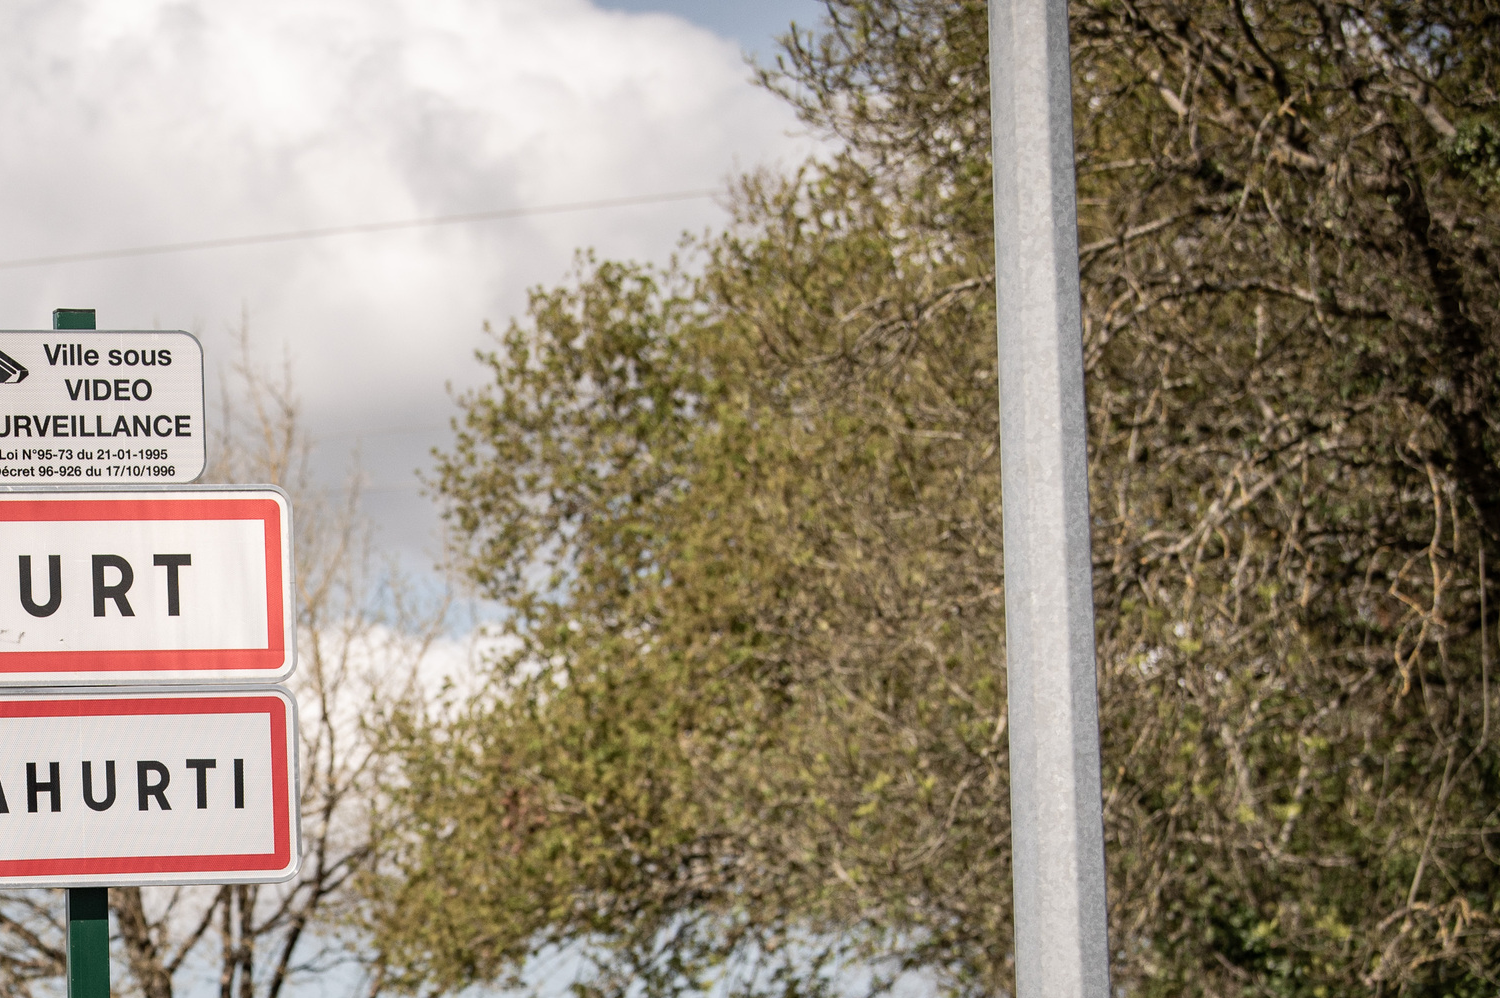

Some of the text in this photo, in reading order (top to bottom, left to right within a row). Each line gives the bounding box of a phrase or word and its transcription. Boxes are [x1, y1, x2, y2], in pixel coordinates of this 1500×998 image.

[43, 343, 172, 367] Ville sous
[64, 378, 153, 401] VIDEO
[77, 449, 93, 461] du
[97, 449, 168, 461] 21-01-1995
[38, 466, 82, 477] 96-926
[85, 466, 102, 477] du
[105, 466, 176, 477] 17/10/1996
[18, 553, 192, 618] URT
